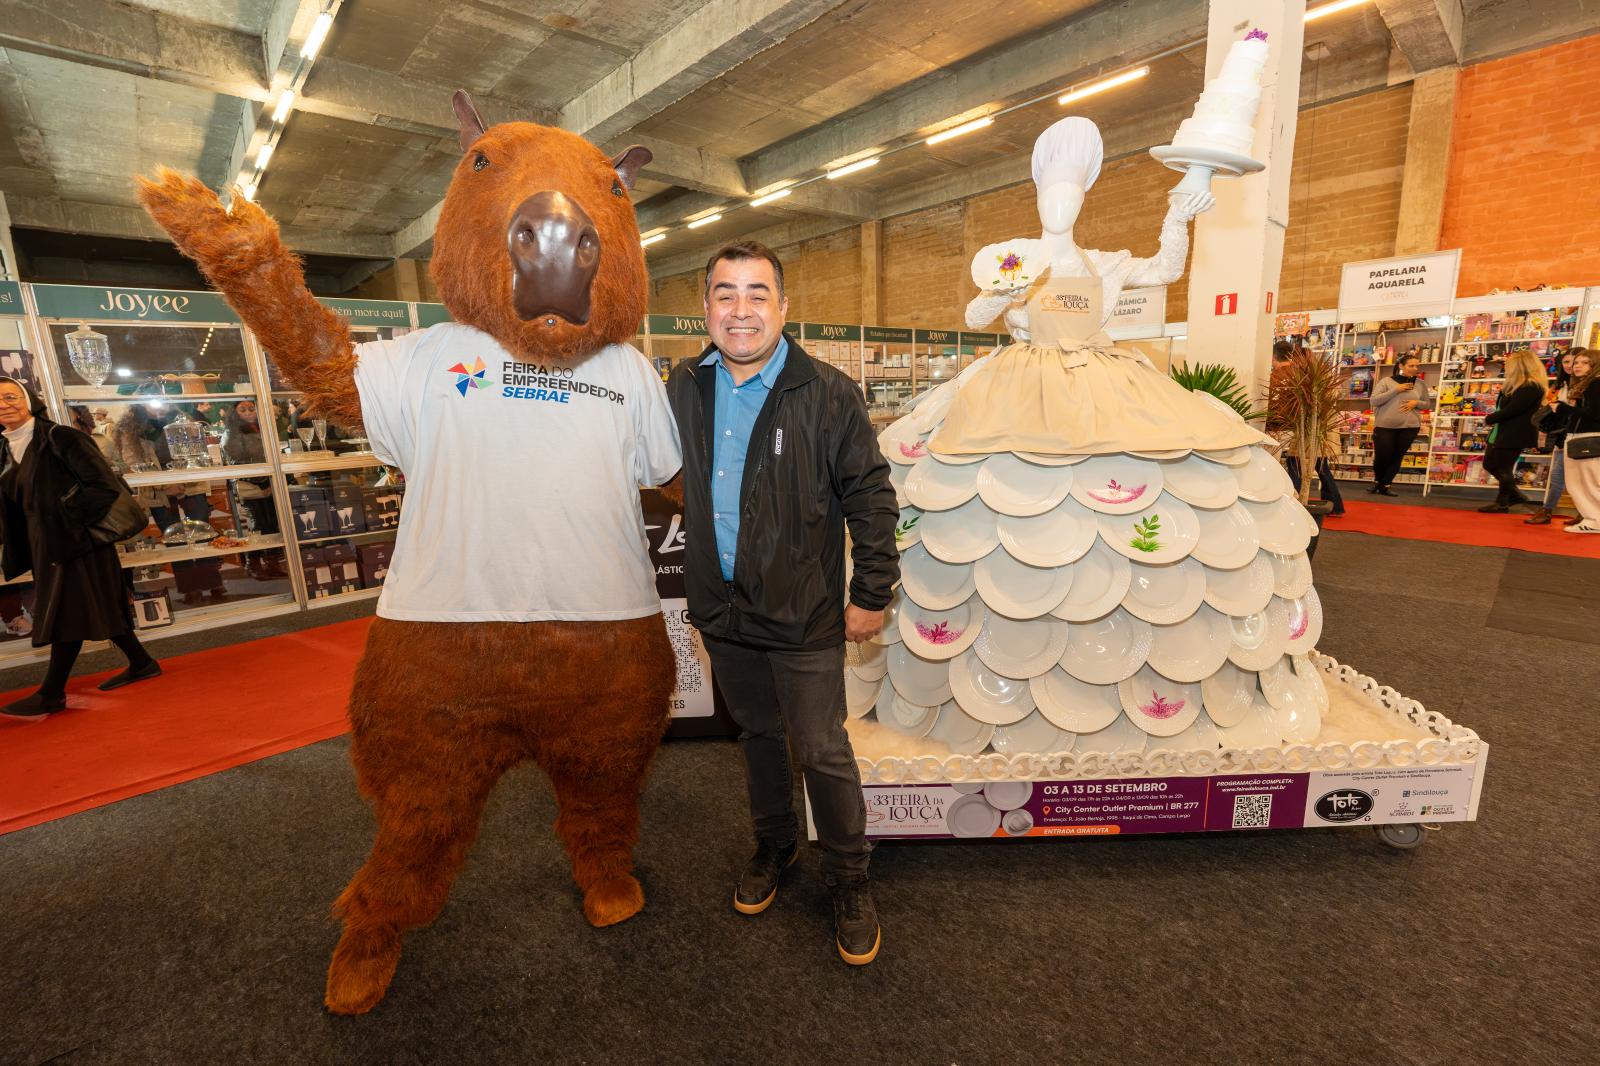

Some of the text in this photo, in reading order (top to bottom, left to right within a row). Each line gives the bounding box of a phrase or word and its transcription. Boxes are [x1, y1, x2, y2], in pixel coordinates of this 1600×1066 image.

[1369, 266, 1426, 278] PAPELARIA
[1368, 278, 1424, 290] AQUARELA
[100, 290, 191, 317] Joyee
[1118, 298, 1147, 306] RÂMICA
[820, 325, 846, 338] Joyee
[503, 361, 574, 378] FEIRA DO
[502, 374, 625, 405] EMPREENDEDOR
[502, 386, 570, 404] SEBRAE
[656, 565, 684, 574] ÁSTIC
[1044, 782, 1168, 794] 03 A 13 DE SETEMBRO
[889, 806, 942, 823] LOUÇA
[1055, 806, 1072, 814] City
